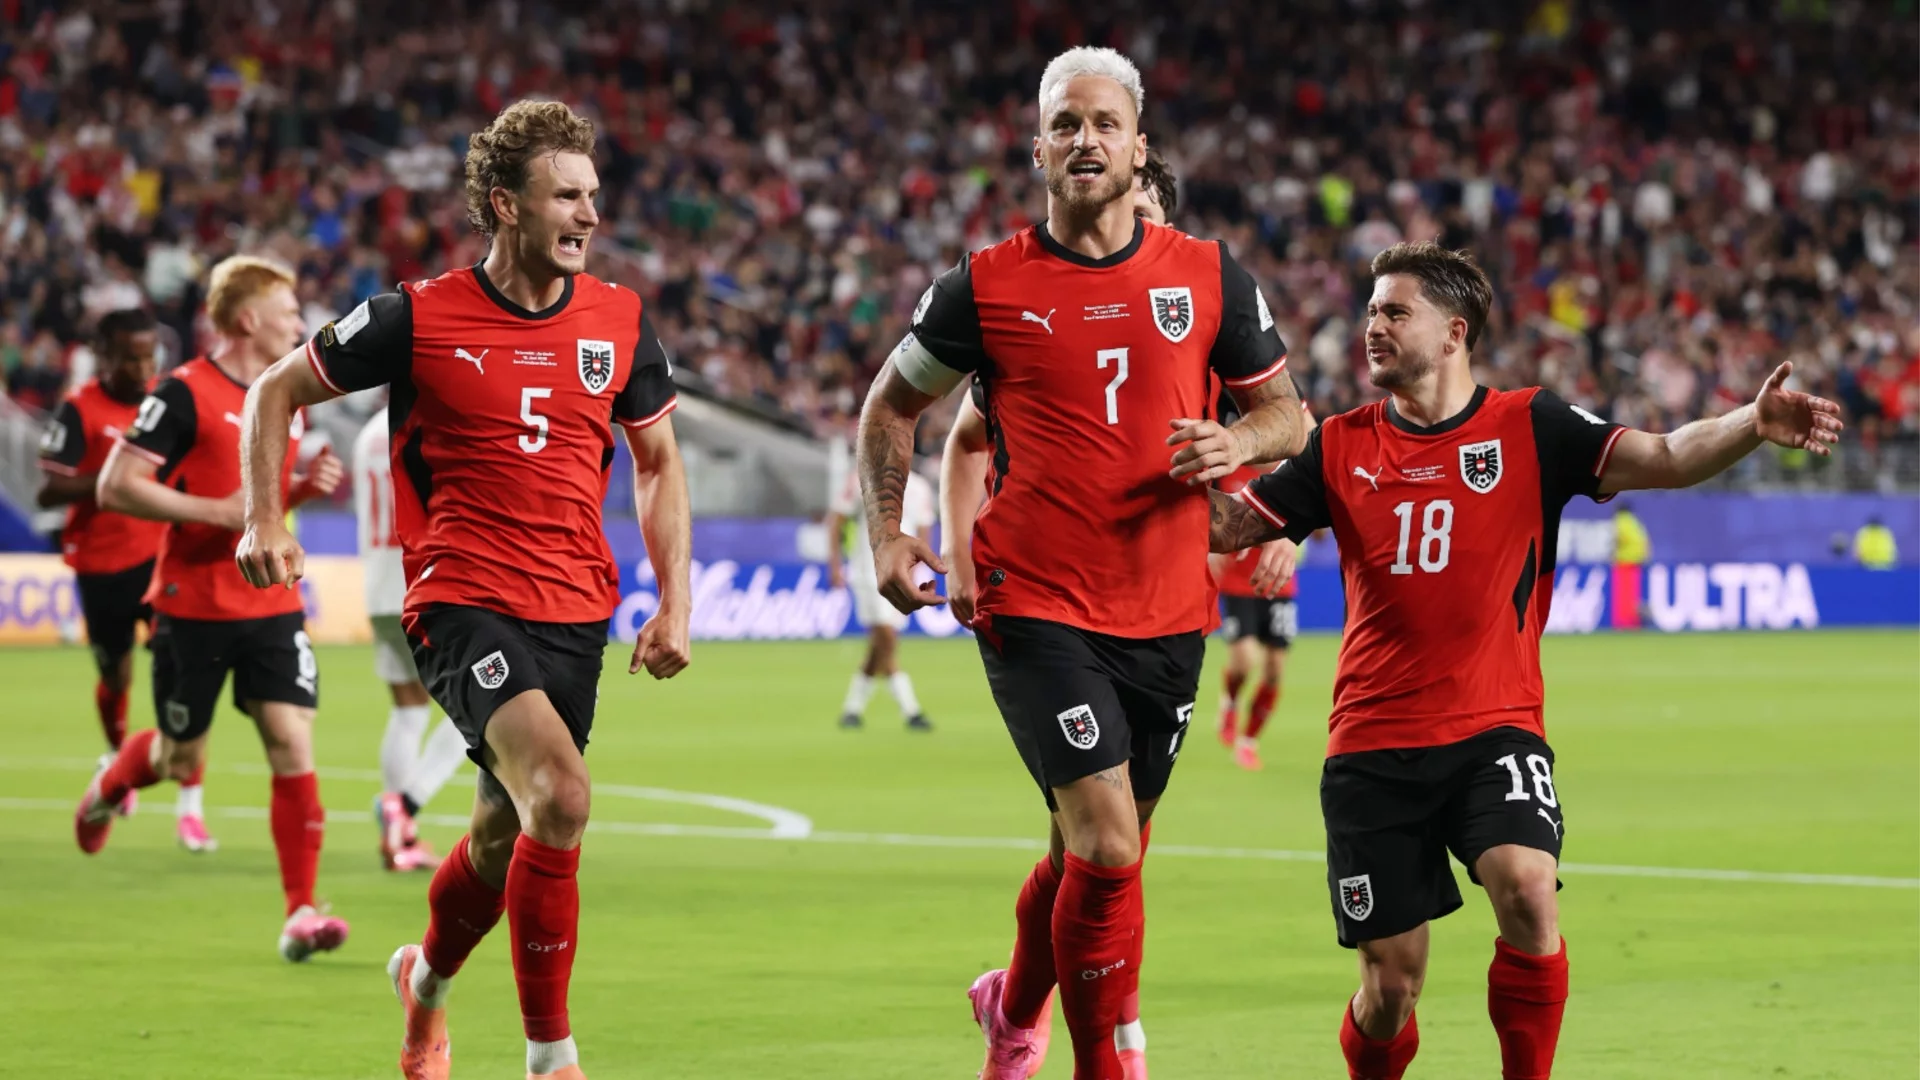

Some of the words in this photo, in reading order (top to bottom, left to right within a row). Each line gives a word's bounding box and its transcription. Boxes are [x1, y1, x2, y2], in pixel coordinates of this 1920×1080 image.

[1097, 347, 1130, 425] 7
[518, 387, 553, 453] 5
[1391, 499, 1454, 575] 18
[1648, 562, 1819, 632] ULTRA
[294, 629, 317, 680] 8
[1168, 701, 1195, 756] 7
[1495, 753, 1558, 808] 18
